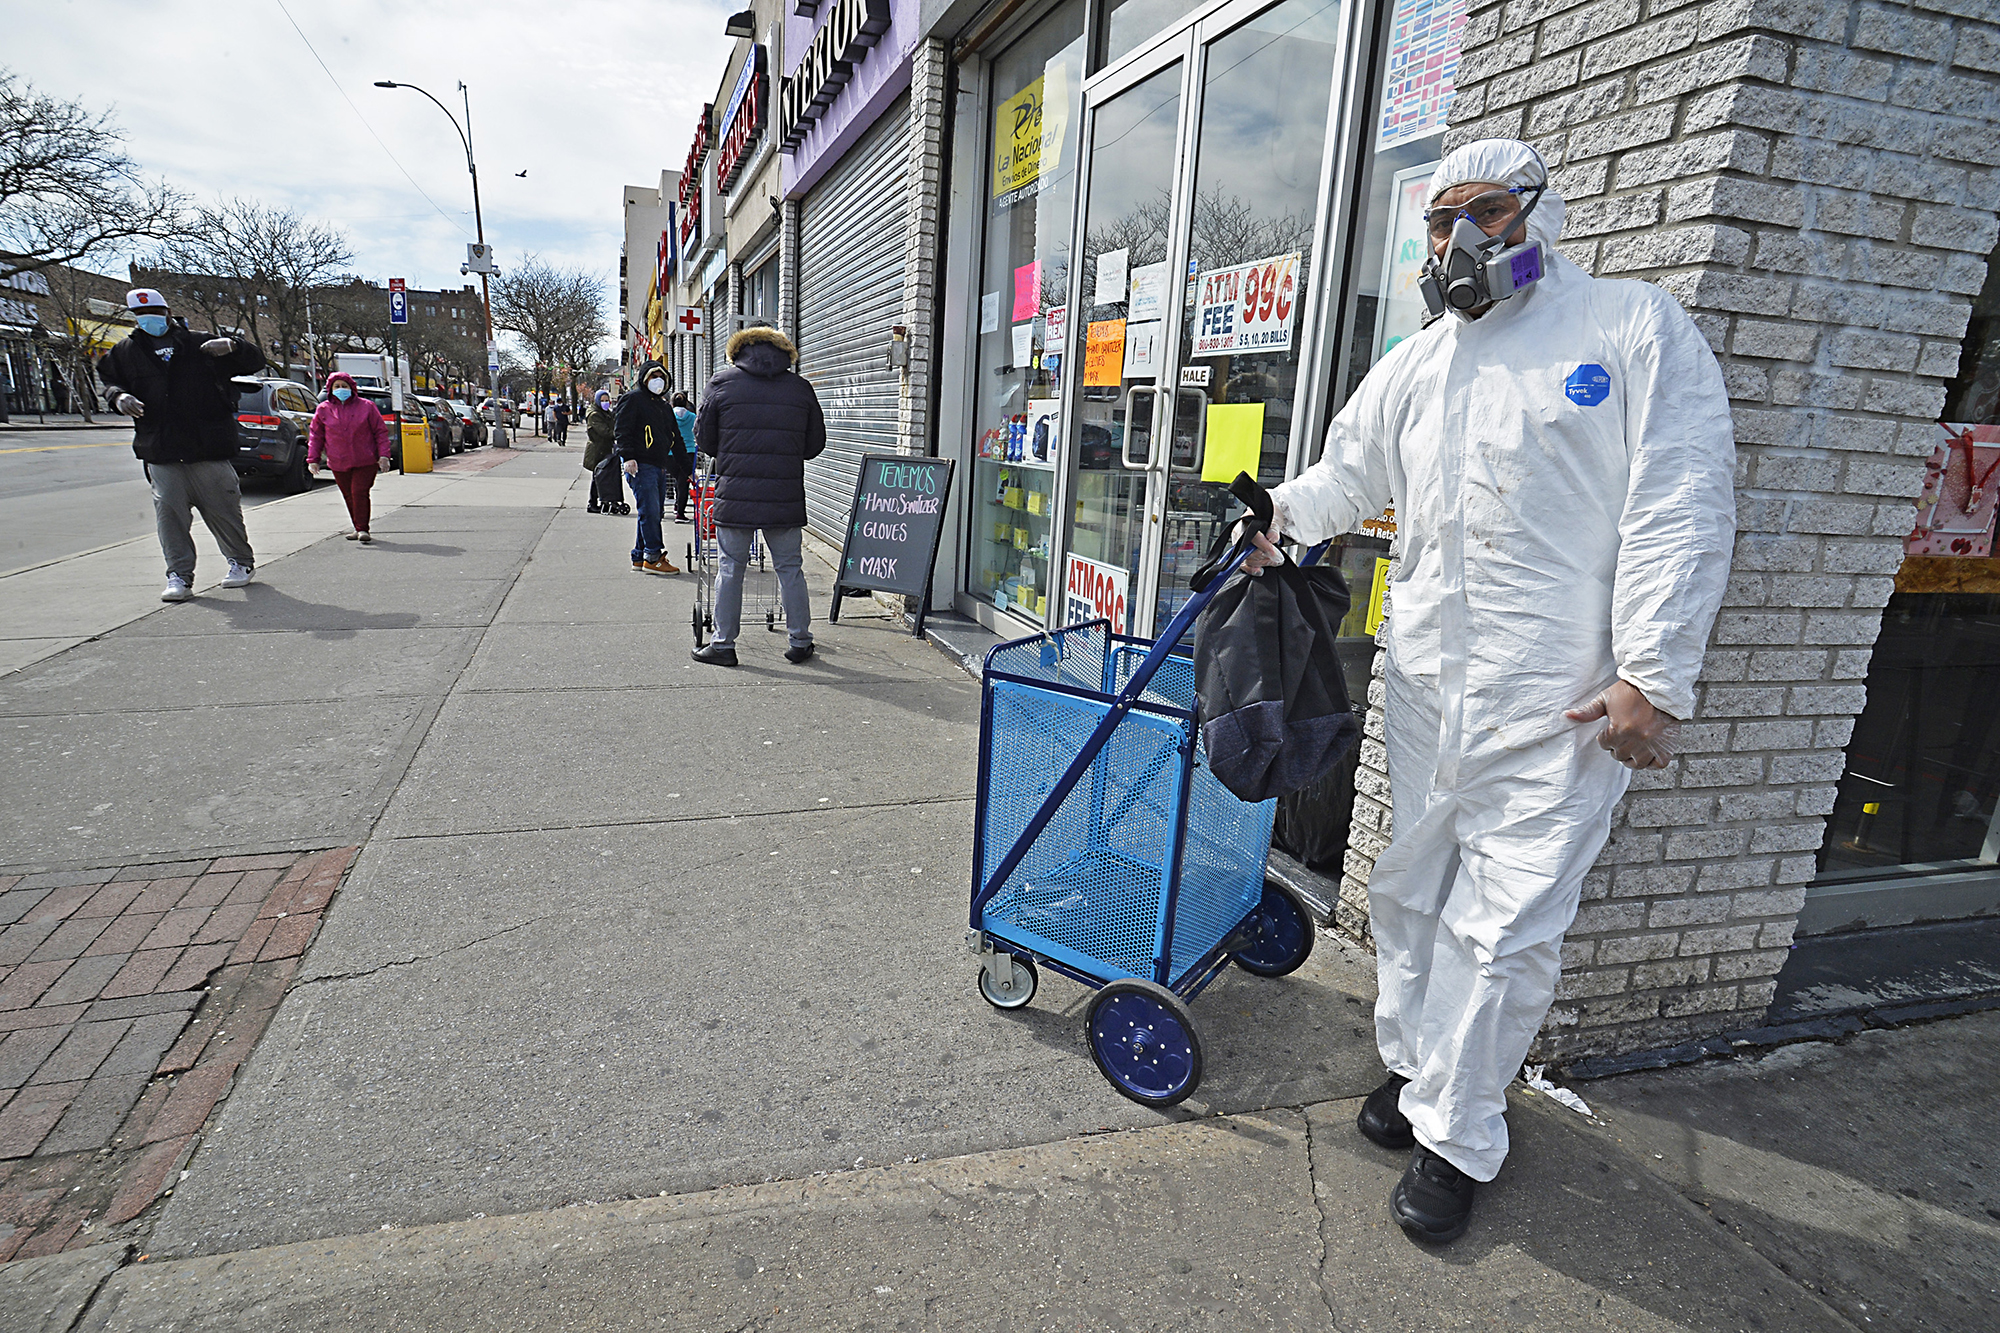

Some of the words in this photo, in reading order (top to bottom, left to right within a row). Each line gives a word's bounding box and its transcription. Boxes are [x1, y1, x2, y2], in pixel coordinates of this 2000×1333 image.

[998, 154, 1010, 173] La
[1012, 123, 1059, 166] Nacional
[1021, 166, 1028, 178] de
[999, 190, 1018, 208] AGENTE
[1018, 176, 1049, 200] AUTORIZADO
[1203, 271, 1240, 306] ATM
[1048, 323, 1065, 339] REN
[1202, 304, 1235, 336] FEE
[1261, 331, 1269, 343] 20
[1270, 329, 1288, 343] BILLS
[1182, 370, 1207, 382] HALE
[1568, 387, 1588, 395] Tyvek
[877, 462, 936, 495] TENEMOS
[863, 521, 908, 542] GLOVES
[859, 556, 898, 580] MASK
[1068, 559, 1095, 601] ATM
[1067, 596, 1091, 627] FEE
